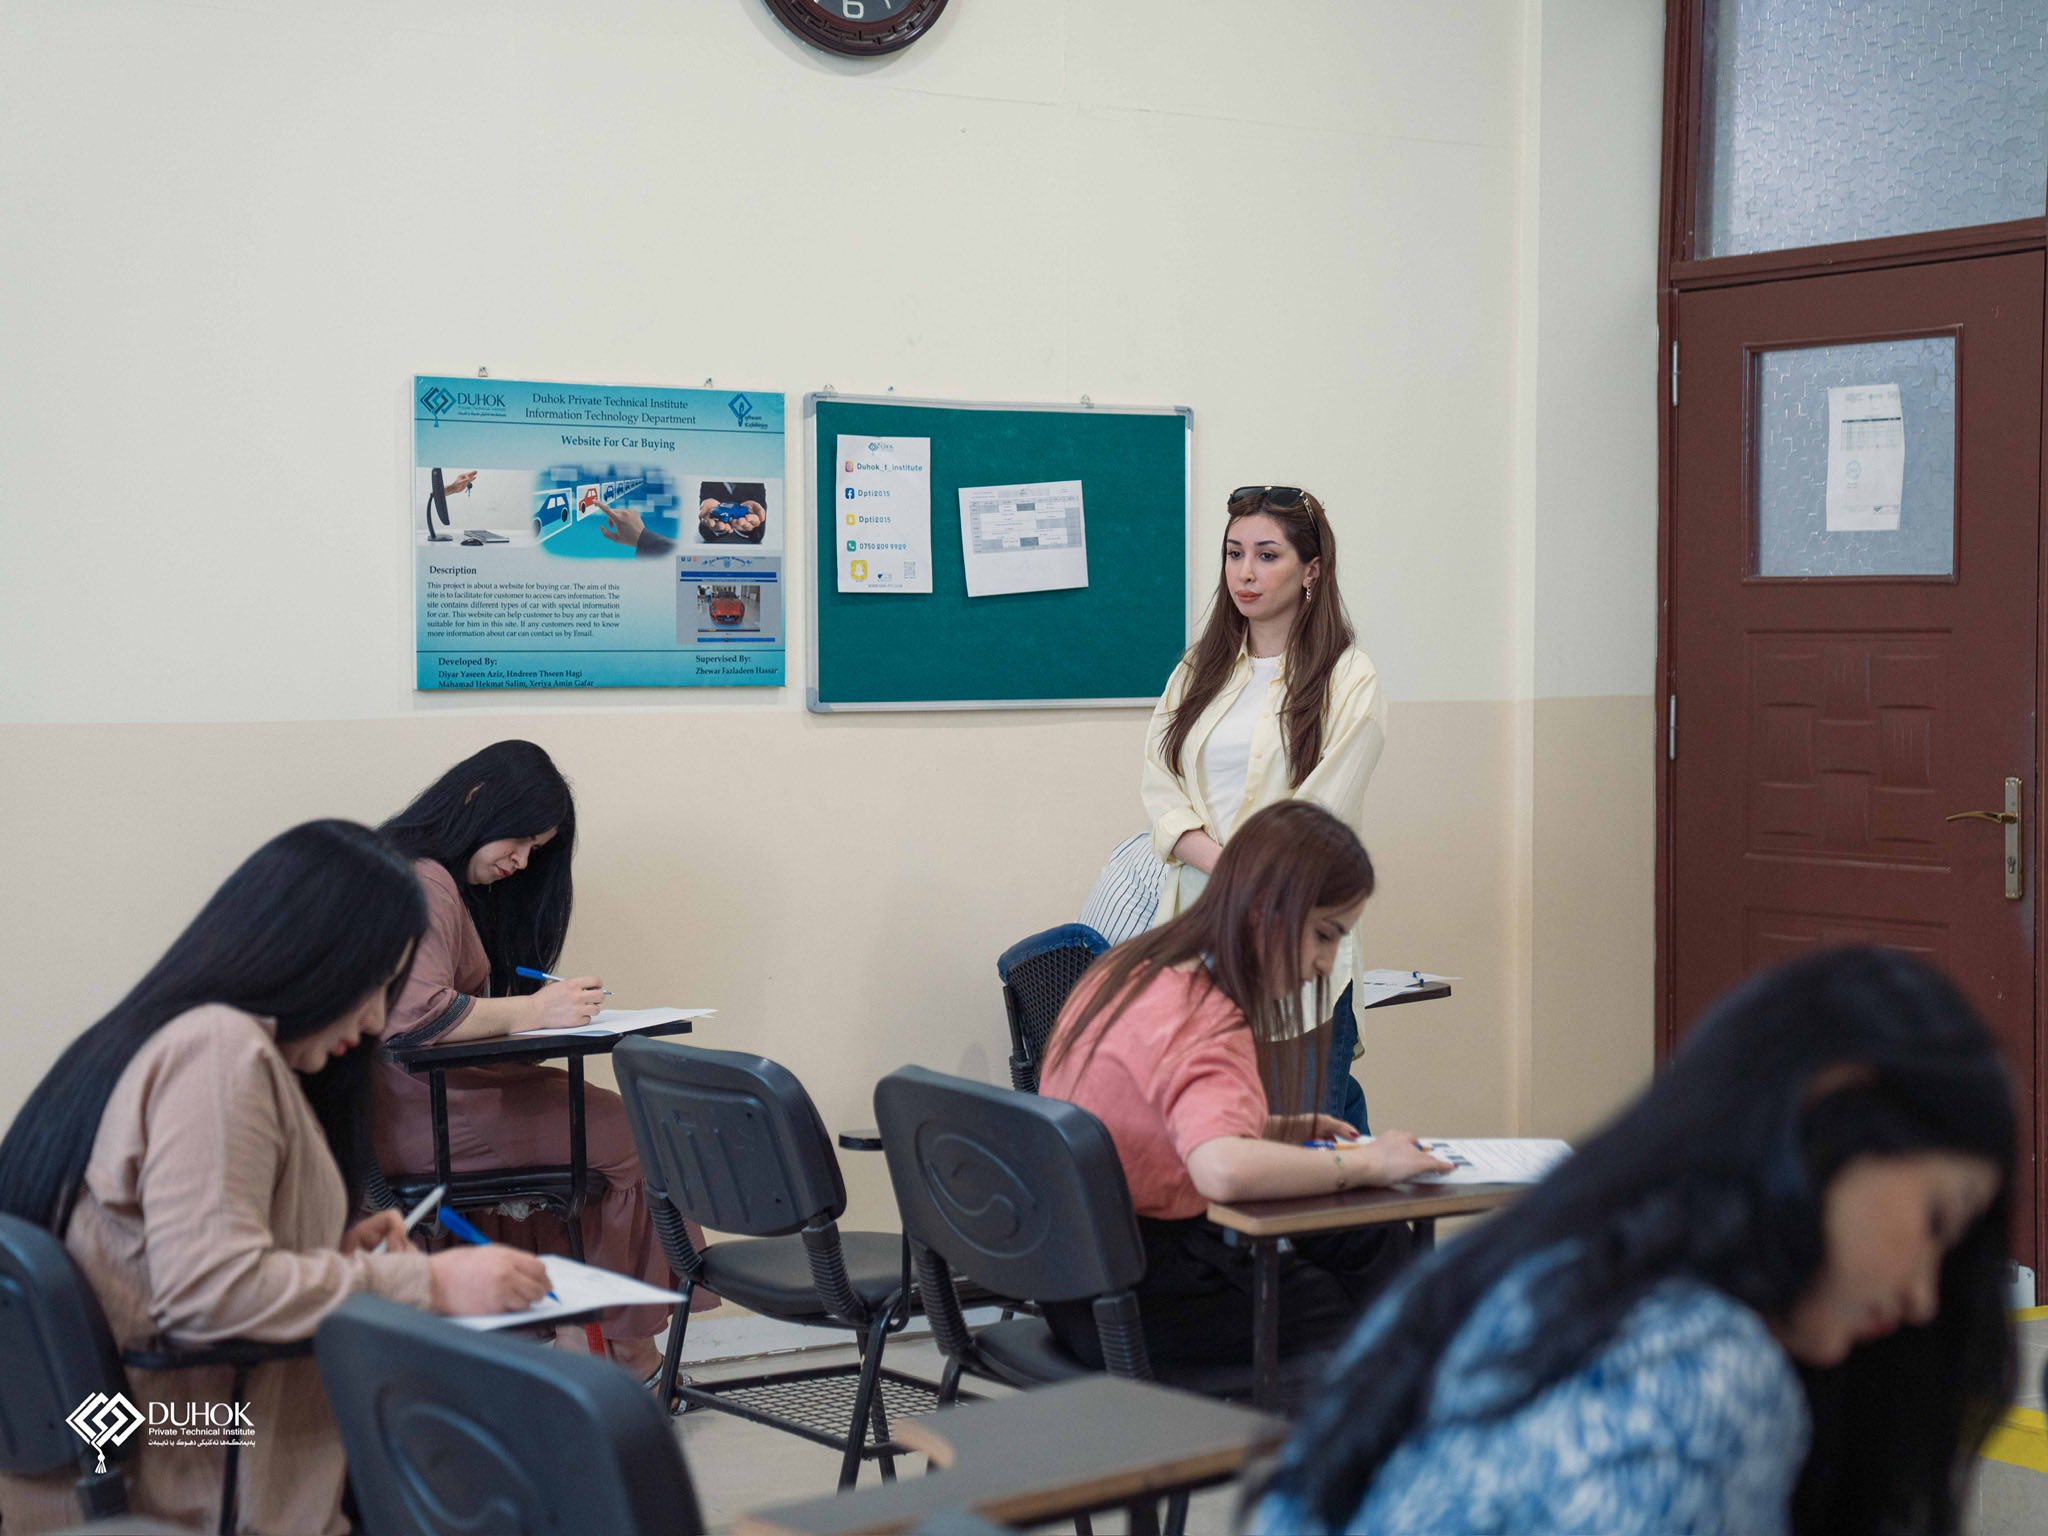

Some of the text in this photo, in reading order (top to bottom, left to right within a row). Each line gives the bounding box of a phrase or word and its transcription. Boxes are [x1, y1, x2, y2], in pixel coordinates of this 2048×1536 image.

[843, 0, 864, 19] 6
[457, 392, 505, 407] DUHOK
[532, 393, 688, 410] Duhok Private Technical Institute
[525, 408, 696, 426] Information Technology Department
[561, 435, 676, 452] Website For Car Buying
[856, 462, 923, 472] Duhok_t_institute
[857, 489, 891, 499] Dpti2015
[858, 515, 892, 525] Dpti2015
[859, 543, 877, 551] 0750
[429, 565, 477, 577] Description
[442, 582, 466, 591] project
[466, 582, 472, 590] is
[474, 582, 492, 590] about
[499, 582, 524, 590] website
[525, 582, 535, 590] for
[536, 582, 559, 592] buying
[572, 582, 585, 590] The
[586, 582, 599, 590] aim
[607, 592, 620, 600] The
[500, 602, 519, 611] types
[558, 602, 581, 611] special
[507, 611, 522, 620] help
[562, 611, 574, 620] buy
[601, 620, 620, 628] know
[564, 630, 573, 639] by
[438, 657, 497, 667] Developed By:
[695, 655, 751, 664] Supervised By:
